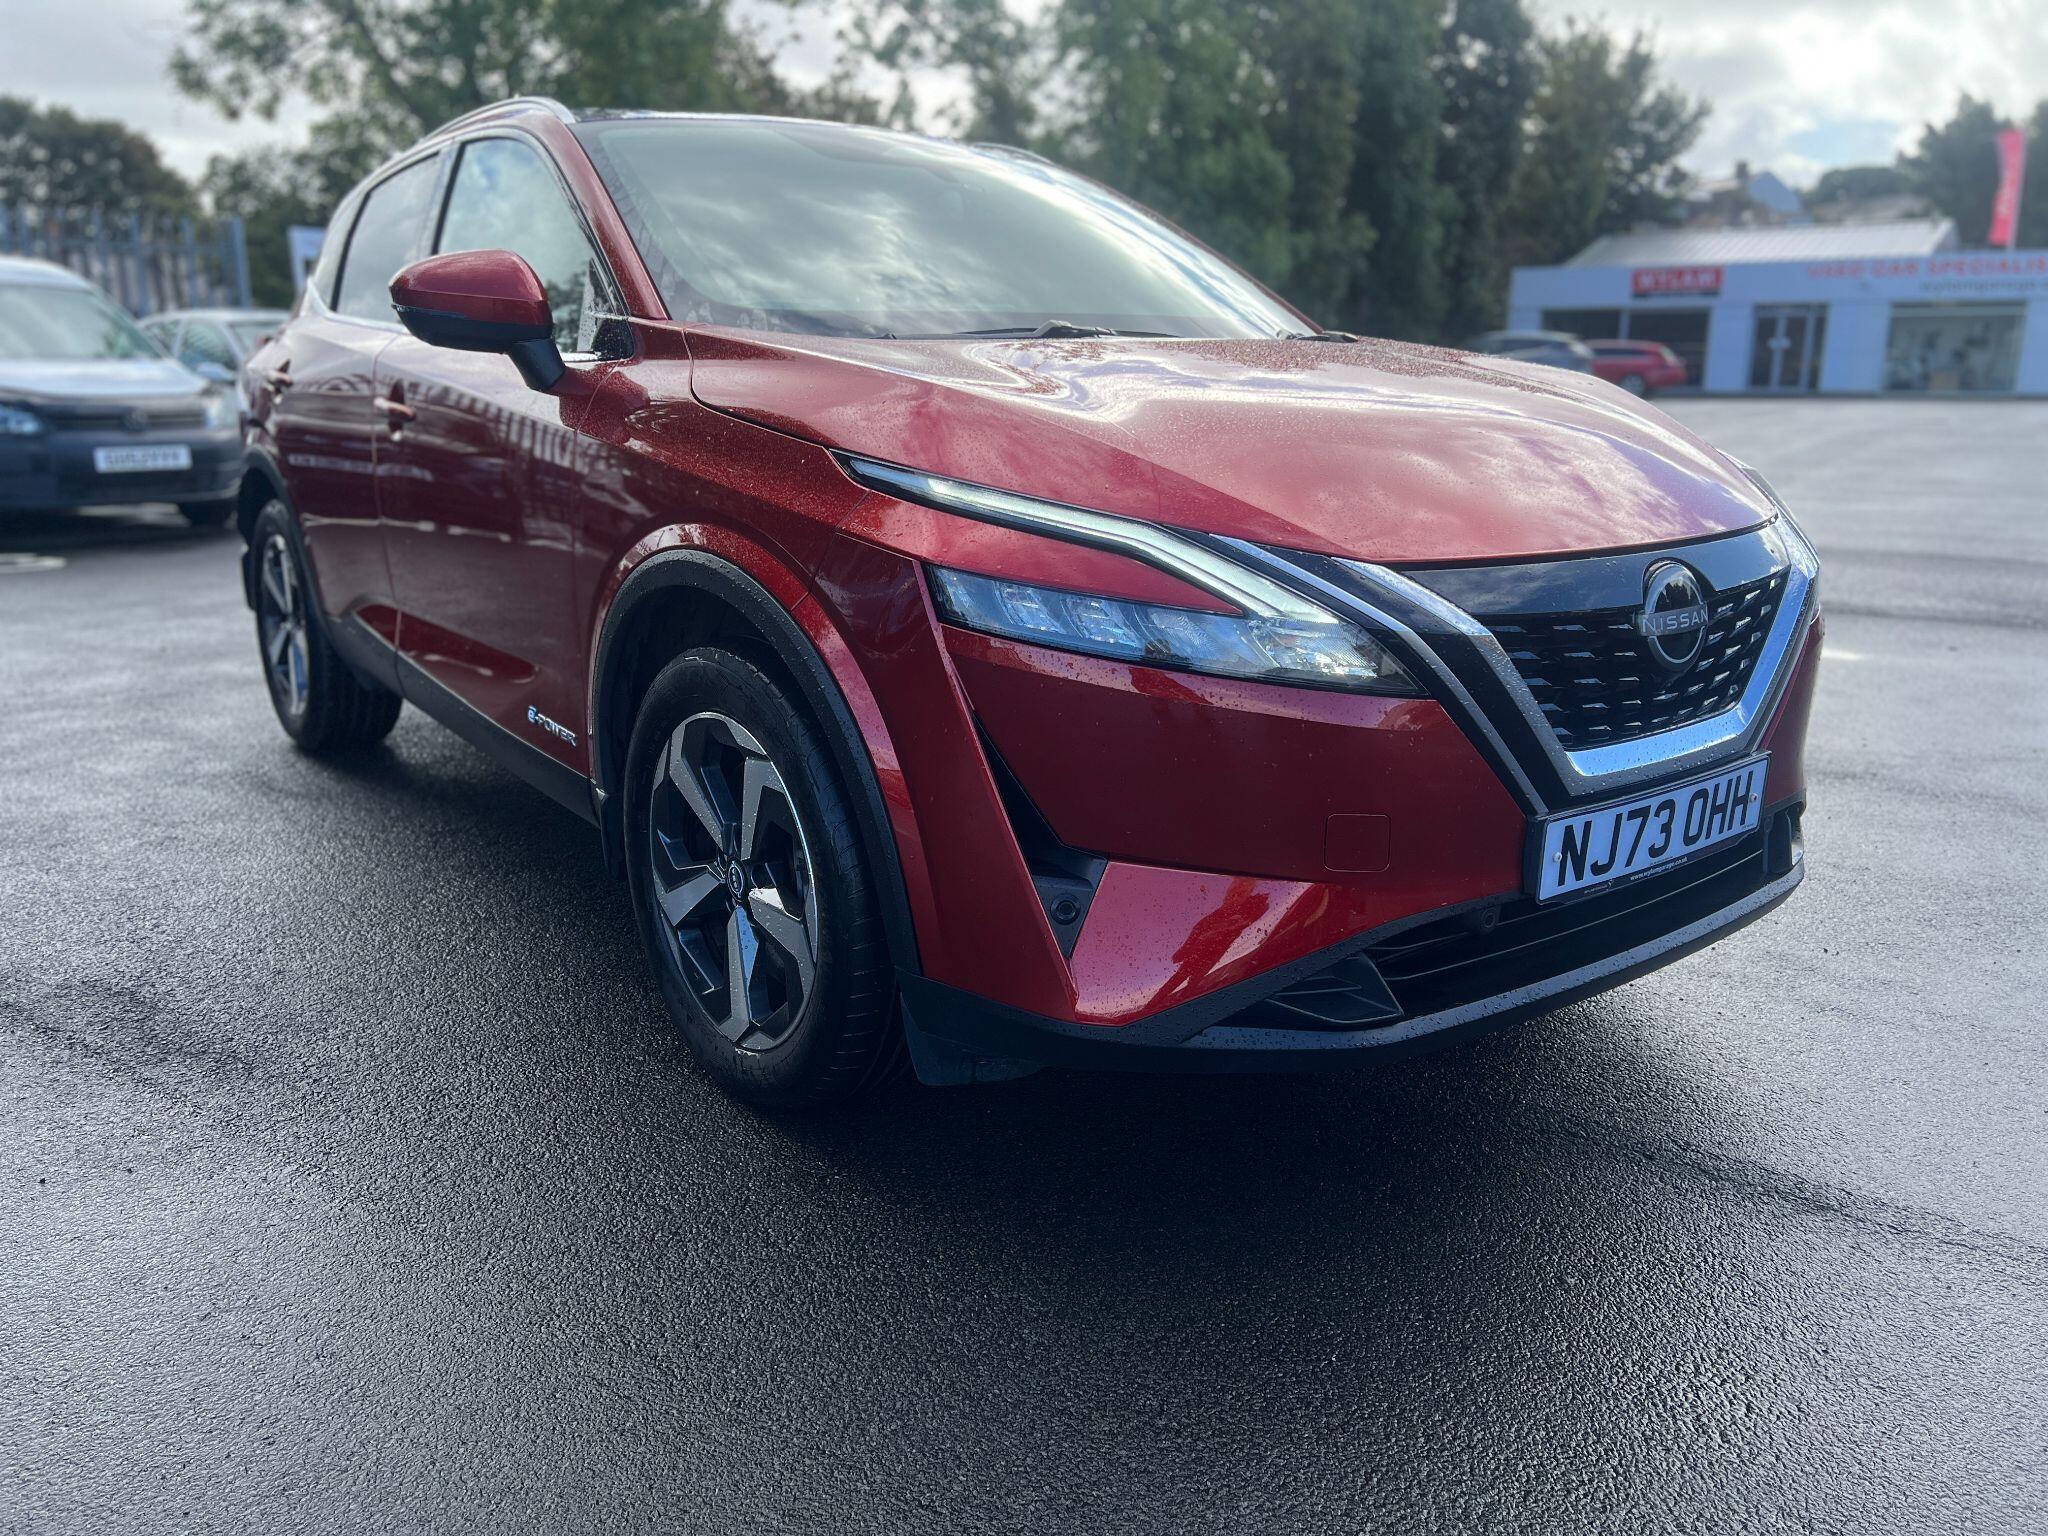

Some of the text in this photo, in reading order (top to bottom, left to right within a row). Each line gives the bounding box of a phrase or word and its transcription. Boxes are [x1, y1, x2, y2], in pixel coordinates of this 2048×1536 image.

[1642, 608, 1708, 633] NISSAN
[1557, 770, 1754, 886] NJ73 OHH
